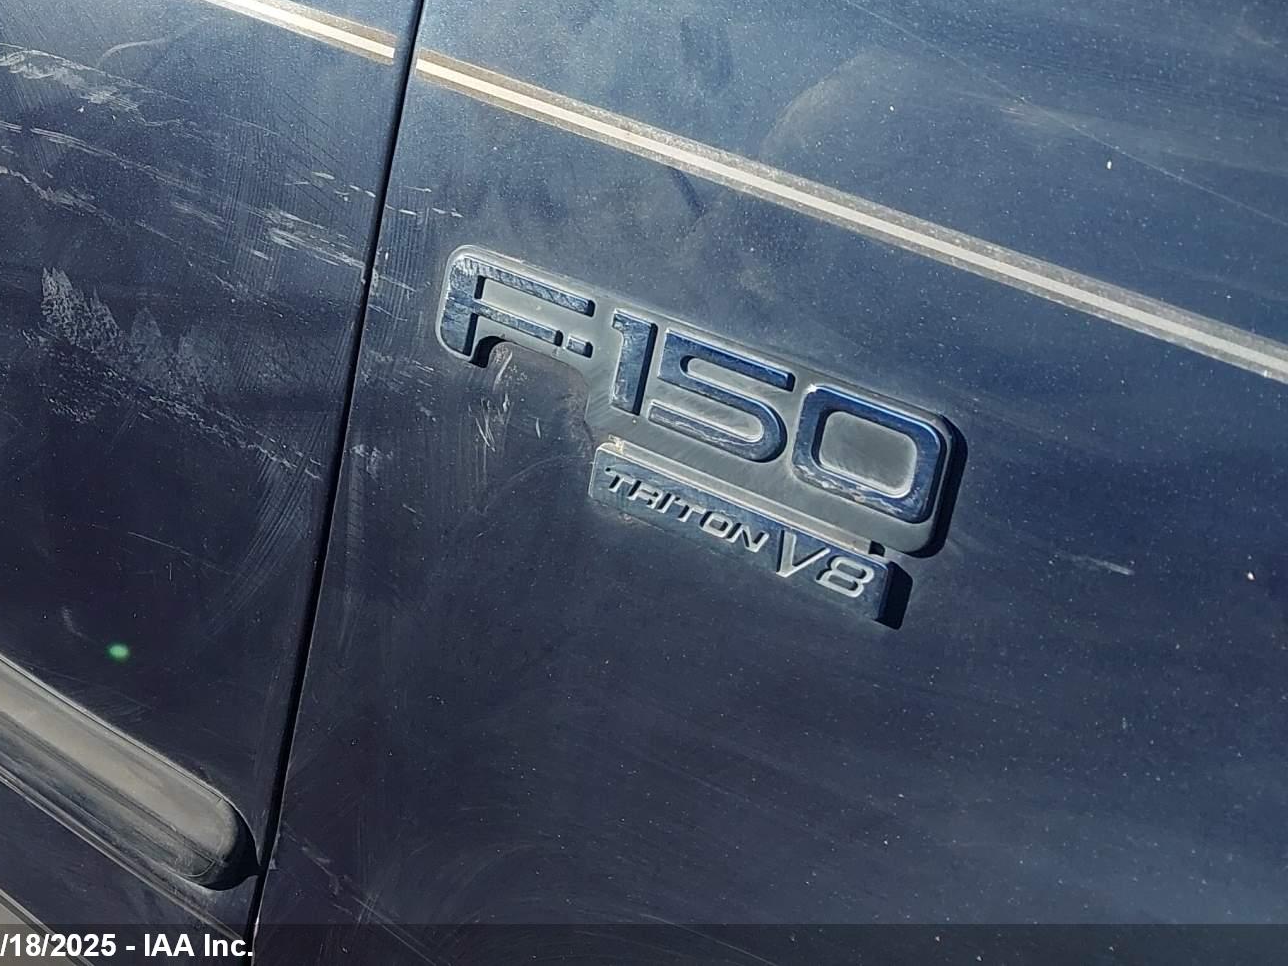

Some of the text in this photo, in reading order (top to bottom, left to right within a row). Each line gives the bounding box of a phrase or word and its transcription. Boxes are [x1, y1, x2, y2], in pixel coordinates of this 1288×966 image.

[440, 254, 948, 524] F-150
[605, 466, 875, 598] TRITON V8
